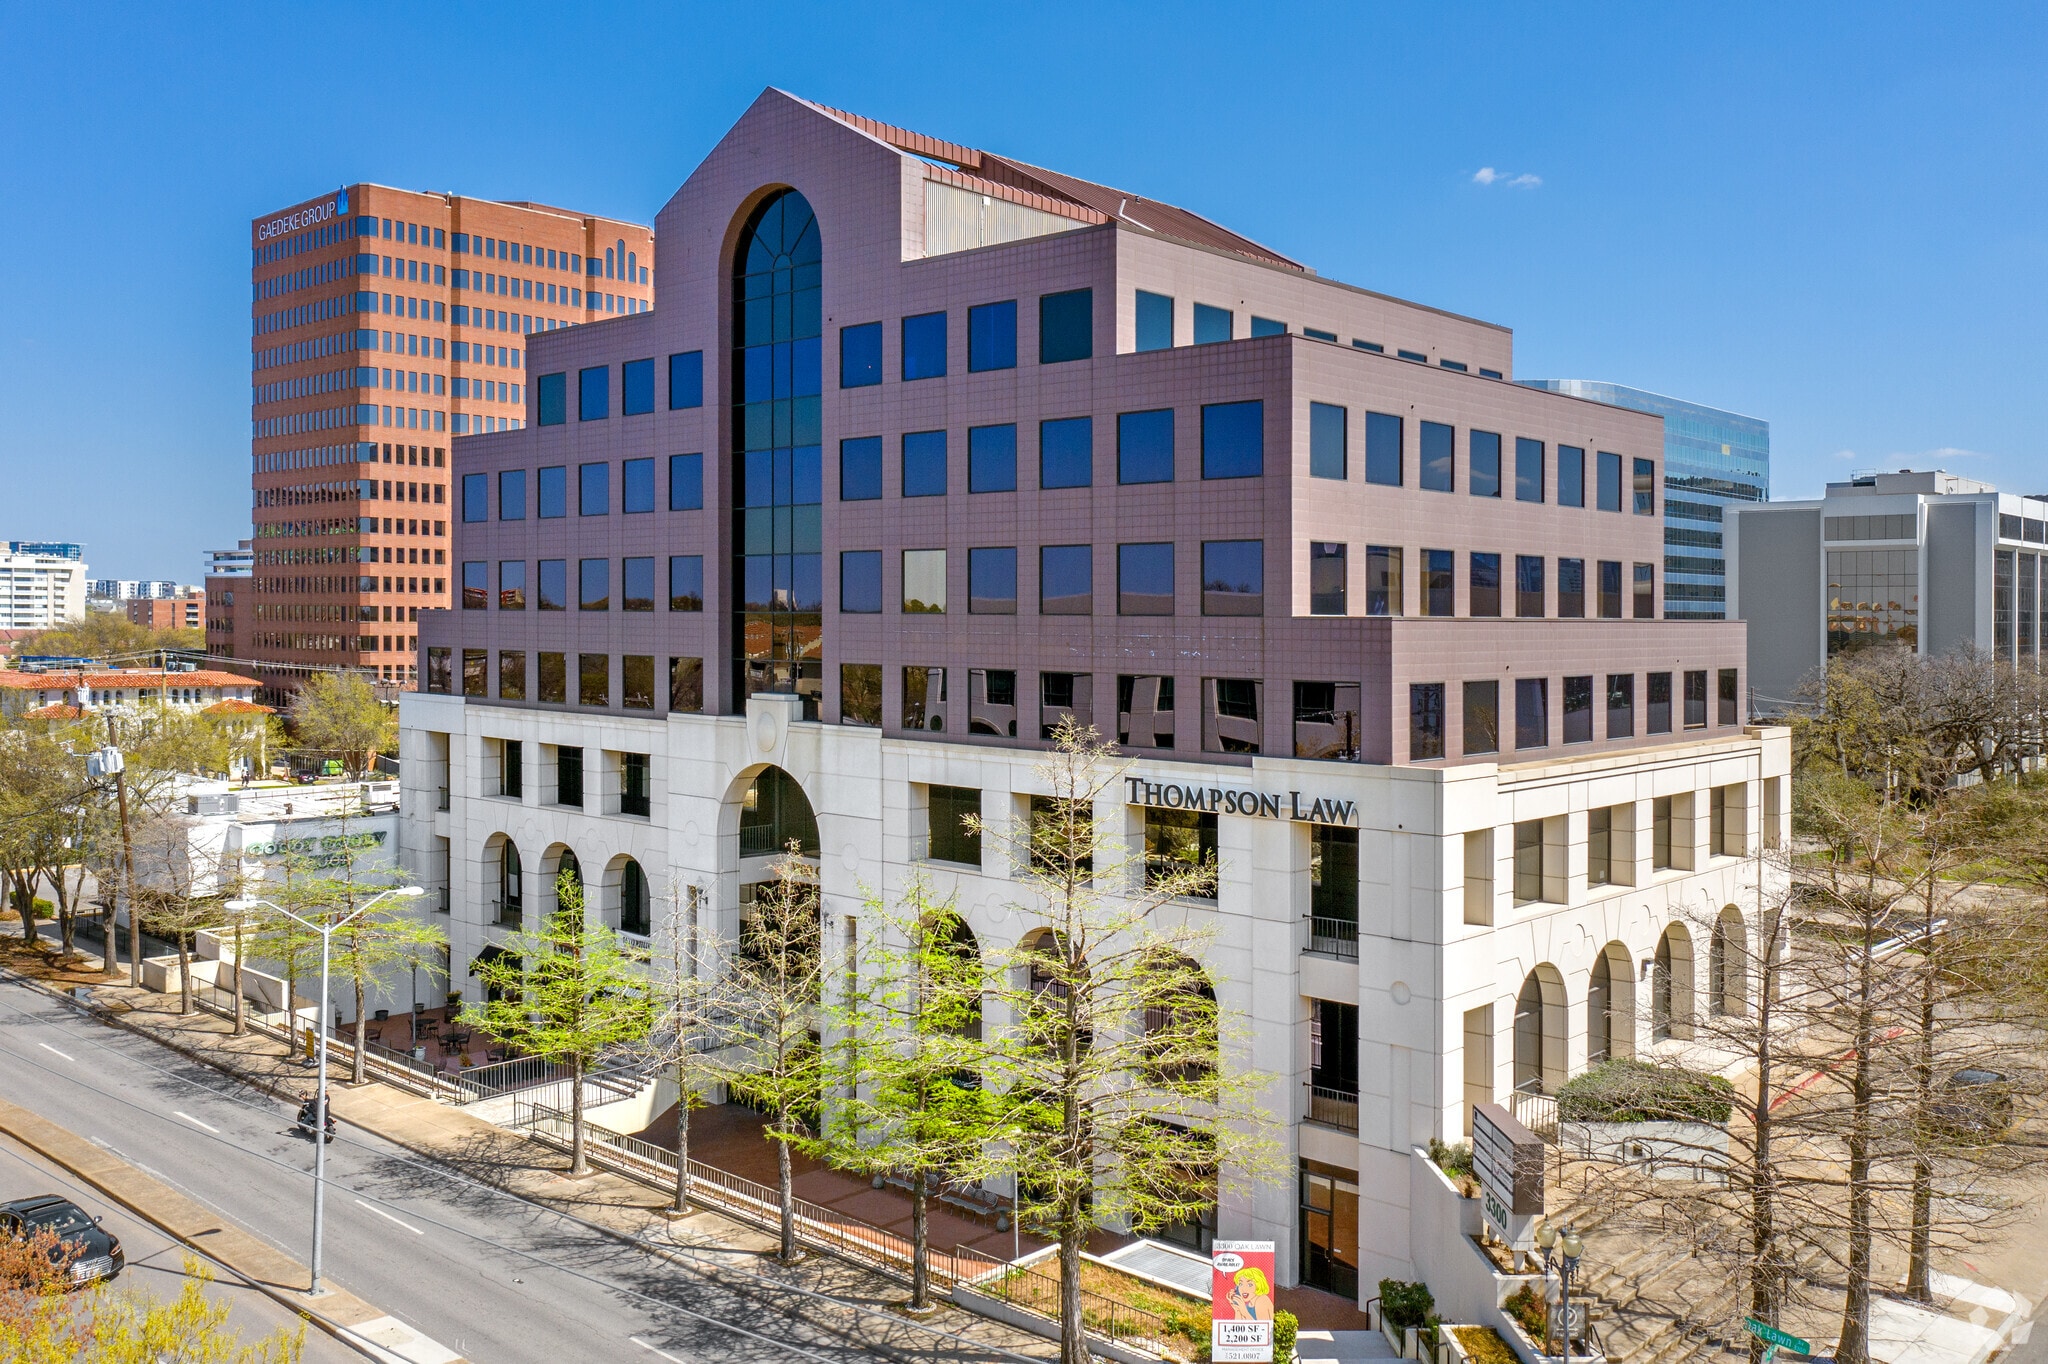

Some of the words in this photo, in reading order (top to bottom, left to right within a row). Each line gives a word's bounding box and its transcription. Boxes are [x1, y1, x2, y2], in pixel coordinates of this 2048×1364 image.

[258, 213, 300, 240] GAEDEKE
[301, 201, 336, 227] GROUP
[1125, 777, 1281, 819] THOMPSON
[1289, 791, 1355, 826] LAW
[1485, 1191, 1507, 1230] 3300
[1223, 1325, 1246, 1333] 1,400
[1248, 1325, 1260, 1333] SF
[1226, 1334, 1248, 1343] 2,200
[1250, 1335, 1262, 1343] SF
[1766, 1328, 1792, 1348] Lawn
